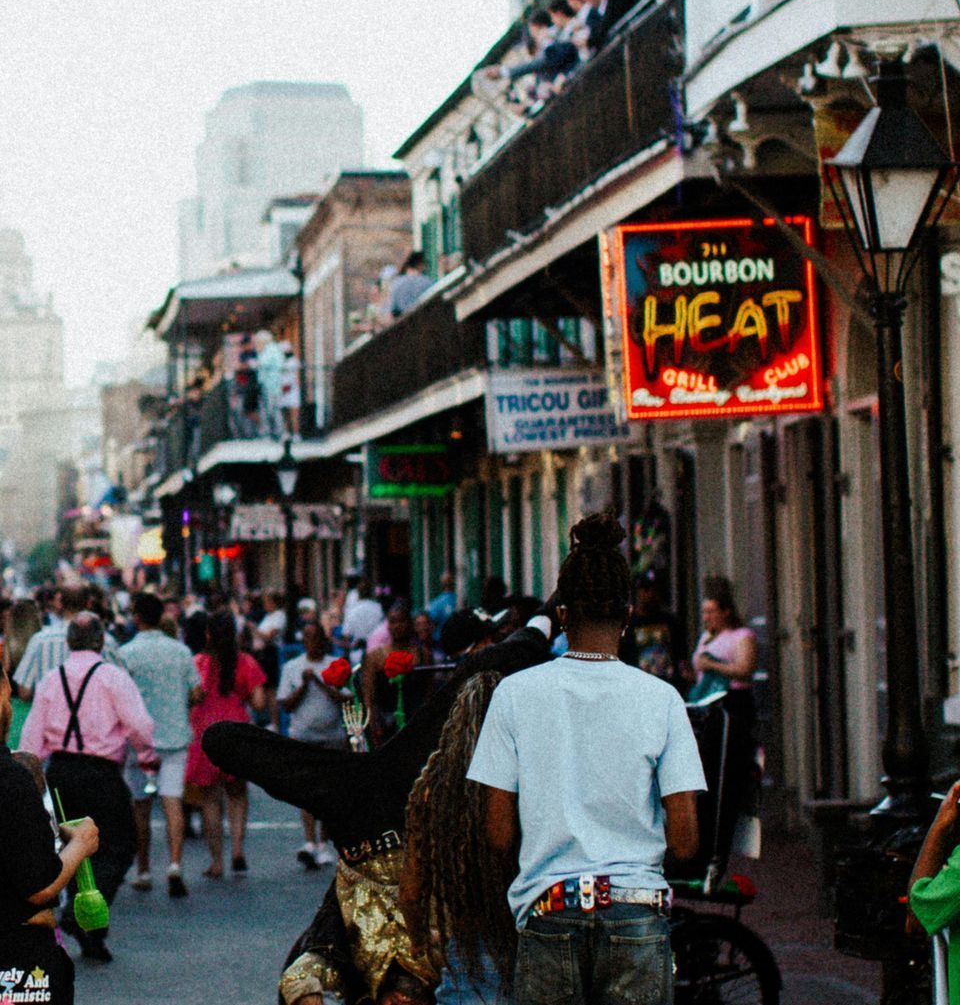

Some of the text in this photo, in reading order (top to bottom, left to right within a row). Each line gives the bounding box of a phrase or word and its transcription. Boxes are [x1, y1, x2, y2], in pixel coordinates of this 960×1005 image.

[659, 257, 775, 286] BOURBON
[643, 290, 803, 366] HEAT
[662, 368, 718, 392] GRILL
[763, 353, 810, 385] CLUB
[496, 391, 570, 413] TRICOU
[577, 388, 608, 409] GIF
[23, 974, 50, 988] And
